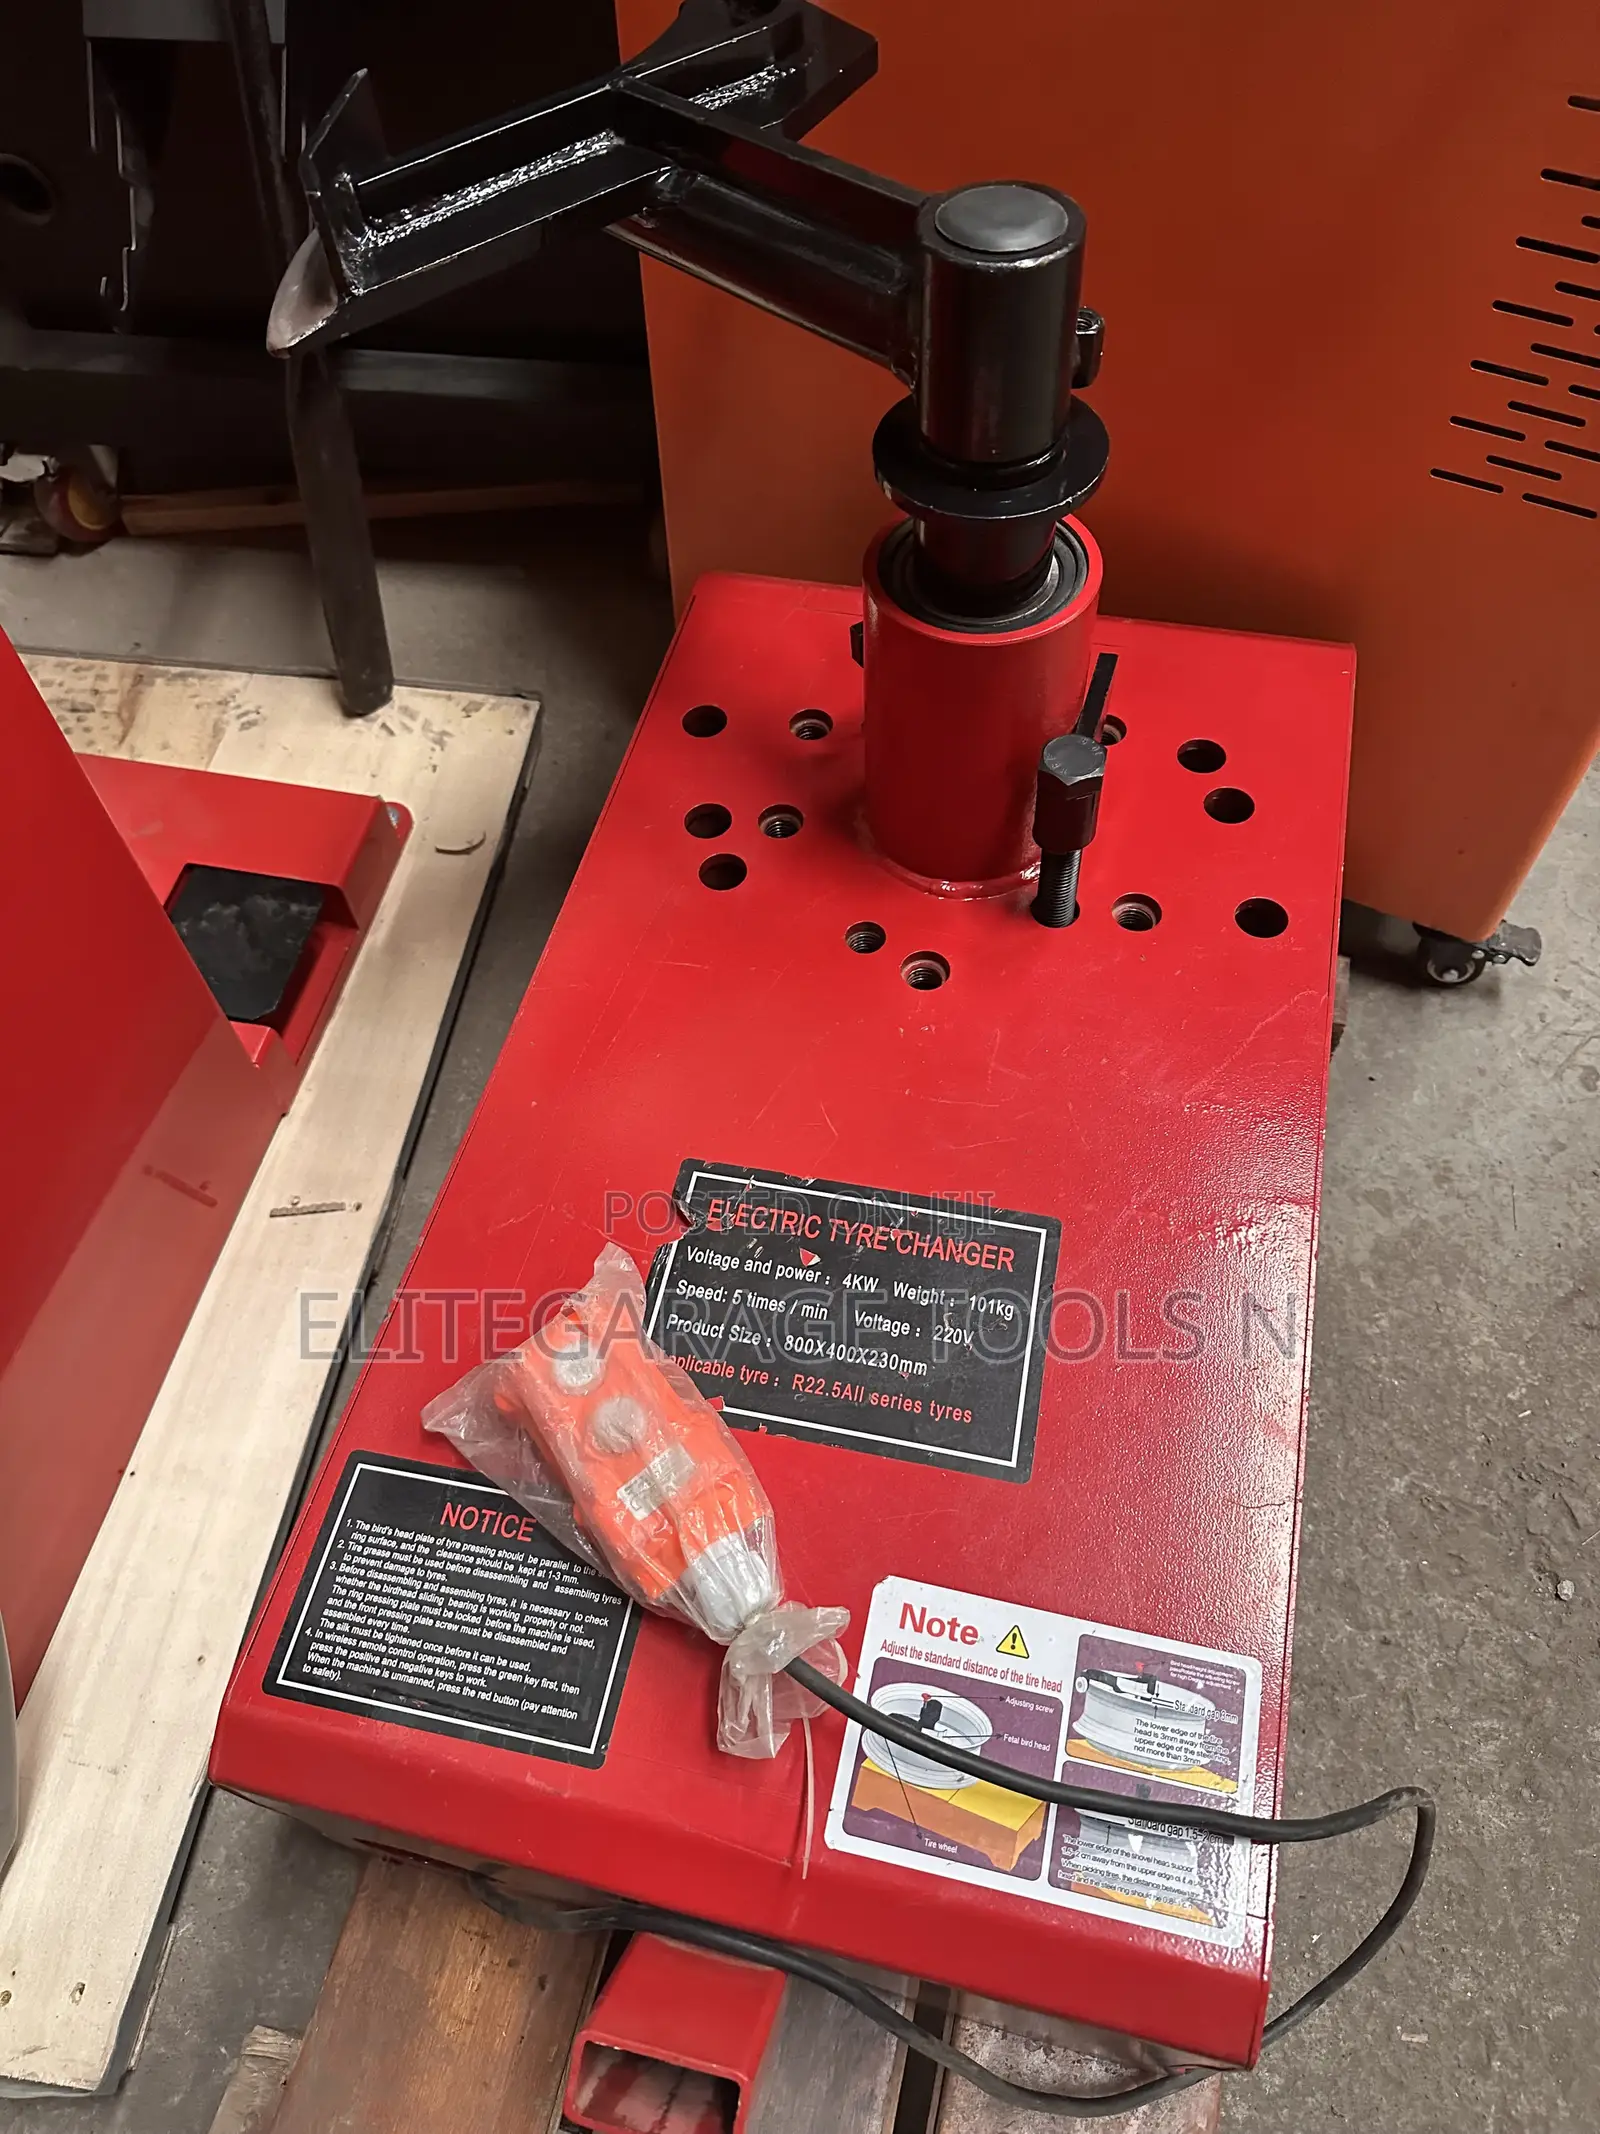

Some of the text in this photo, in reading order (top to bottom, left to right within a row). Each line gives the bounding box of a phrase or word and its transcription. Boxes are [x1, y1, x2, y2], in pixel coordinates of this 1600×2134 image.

[707, 1199, 1016, 1272] ELECTRIC TYRE CHANGER
[683, 1245, 741, 1272] Voltage
[743, 1256, 772, 1274] and
[774, 1264, 821, 1287] power
[842, 1273, 879, 1292] 4KW
[891, 1282, 946, 1308] Weight
[968, 1295, 1014, 1320] 101kg
[674, 1279, 729, 1306] Speed:
[731, 1289, 743, 1305] 5
[745, 1292, 788, 1313] times
[789, 1299, 798, 1315] /
[801, 1301, 829, 1320] min
[851, 1310, 911, 1339] Voltage
[933, 1325, 974, 1347] 220V
[666, 1313, 725, 1338] Product
[728, 1325, 763, 1345] Size
[783, 1334, 928, 1376] 800X400X230mm
[738, 1365, 770, 1388] tyre
[869, 1389, 923, 1413] series
[928, 1400, 973, 1427] tyres
[440, 1501, 537, 1542] NOTICE
[336, 1538, 621, 1605] 2. Tire grease must be used before disassembling and assembling tyres
[346, 1517, 353, 1528] 1.
[355, 1519, 371, 1531] The
[370, 1522, 393, 1536] bird's
[392, 1527, 415, 1540] head
[413, 1532, 435, 1544] plate
[435, 1536, 446, 1546] of
[444, 1537, 461, 1549] tyre
[460, 1542, 496, 1558] pressing
[496, 1548, 525, 1562] should
[526, 1553, 539, 1564] be
[538, 1558, 570, 1570] parallel
[572, 1563, 581, 1573] to
[582, 1565, 597, 1577] the
[350, 1530, 579, 1584] ring surface, and the clearance should be kept at 1-3 mm.
[328, 1560, 337, 1570] 3.
[338, 1561, 365, 1576] Before
[365, 1568, 422, 1590] disassembling
[422, 1581, 440, 1591] and
[439, 1584, 485, 1603] assembling
[509, 1597, 517, 1608] it
[519, 1599, 528, 1610] is
[528, 1603, 571, 1620] necessary
[573, 1611, 583, 1621] to
[583, 1613, 609, 1627] check
[334, 1574, 368, 1588] whether
[367, 1580, 381, 1591] the
[381, 1582, 418, 1599] birdhead
[417, 1591, 445, 1606] sliding
[447, 1596, 479, 1614] bearing
[478, 1602, 487, 1614] is
[488, 1606, 520, 1622] working
[558, 1621, 569, 1630] or
[568, 1623, 584, 1634] not.
[899, 1602, 979, 1646] Note
[301, 1662, 311, 1673] to
[304, 1626, 580, 1695] 4. In wireless remote control operation, press the green key first, then
[879, 1638, 1063, 1693] Adjust the standard distance of the tire head
[1004, 1695, 1055, 1714] Adjusting screw
[1135, 1718, 1149, 1728] The
[1149, 1721, 1169, 1732] lower
[1170, 1726, 1188, 1738] edge
[1189, 1730, 1197, 1738] of
[1174, 1699, 1205, 1717] Stadard
[1020, 1737, 1033, 1748] bird
[1033, 1740, 1051, 1752] head
[1133, 1744, 1145, 1753] not
[1146, 1748, 1165, 1757] more
[1166, 1751, 1182, 1761] than
[1134, 1727, 1152, 1737] head
[1160, 1732, 1178, 1743] 3mm
[1179, 1738, 1198, 1749] away
[1134, 1736, 1155, 1748] upper
[1156, 1741, 1174, 1752] edge
[1175, 1745, 1183, 1753] of
[1184, 1747, 1195, 1755] the
[923, 1837, 958, 1854] Tire wheel
[1166, 1823, 1183, 1839] gap
